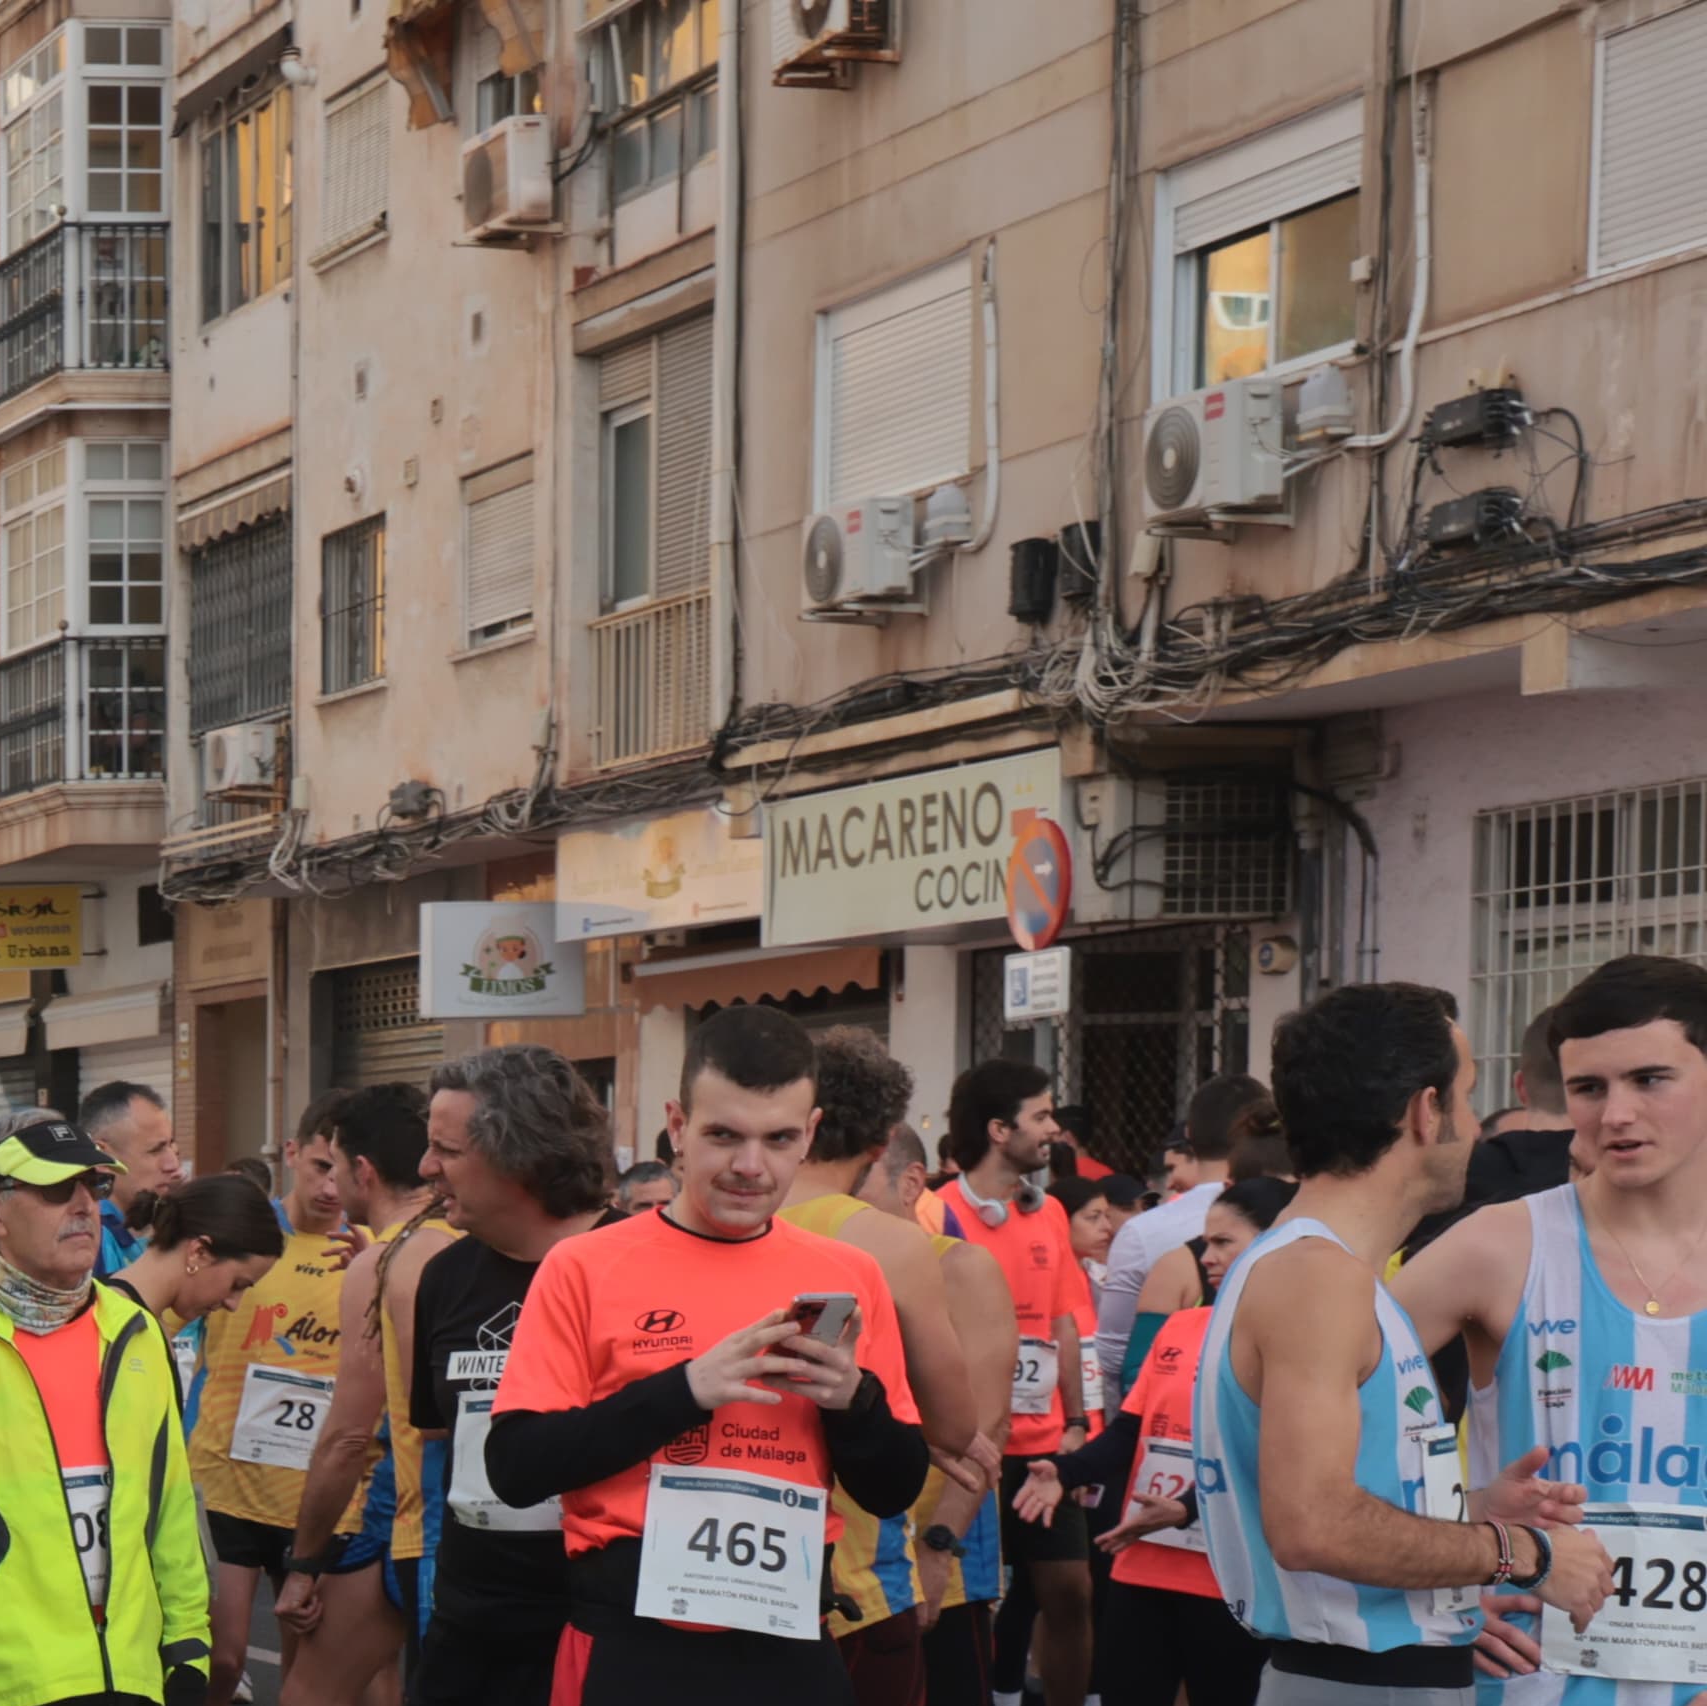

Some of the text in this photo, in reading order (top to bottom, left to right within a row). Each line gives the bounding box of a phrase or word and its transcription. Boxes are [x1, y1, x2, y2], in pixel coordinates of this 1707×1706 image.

[780, 781, 1003, 878] MACARENO
[11, 924, 71, 937] woman
[7, 944, 71, 958] Urbana
[479, 978, 537, 996] LIMOS
[633, 1335, 692, 1348] HYUNDAI
[275, 1400, 317, 1431] 28
[721, 1423, 780, 1442] Ciudad
[720, 1443, 807, 1464] de Málaga
[687, 1517, 787, 1572] 465
[1610, 1556, 1707, 1612] 428
[1611, 1636, 1656, 1647] MARATÓN
[1657, 1639, 1679, 1648] PEÑA
